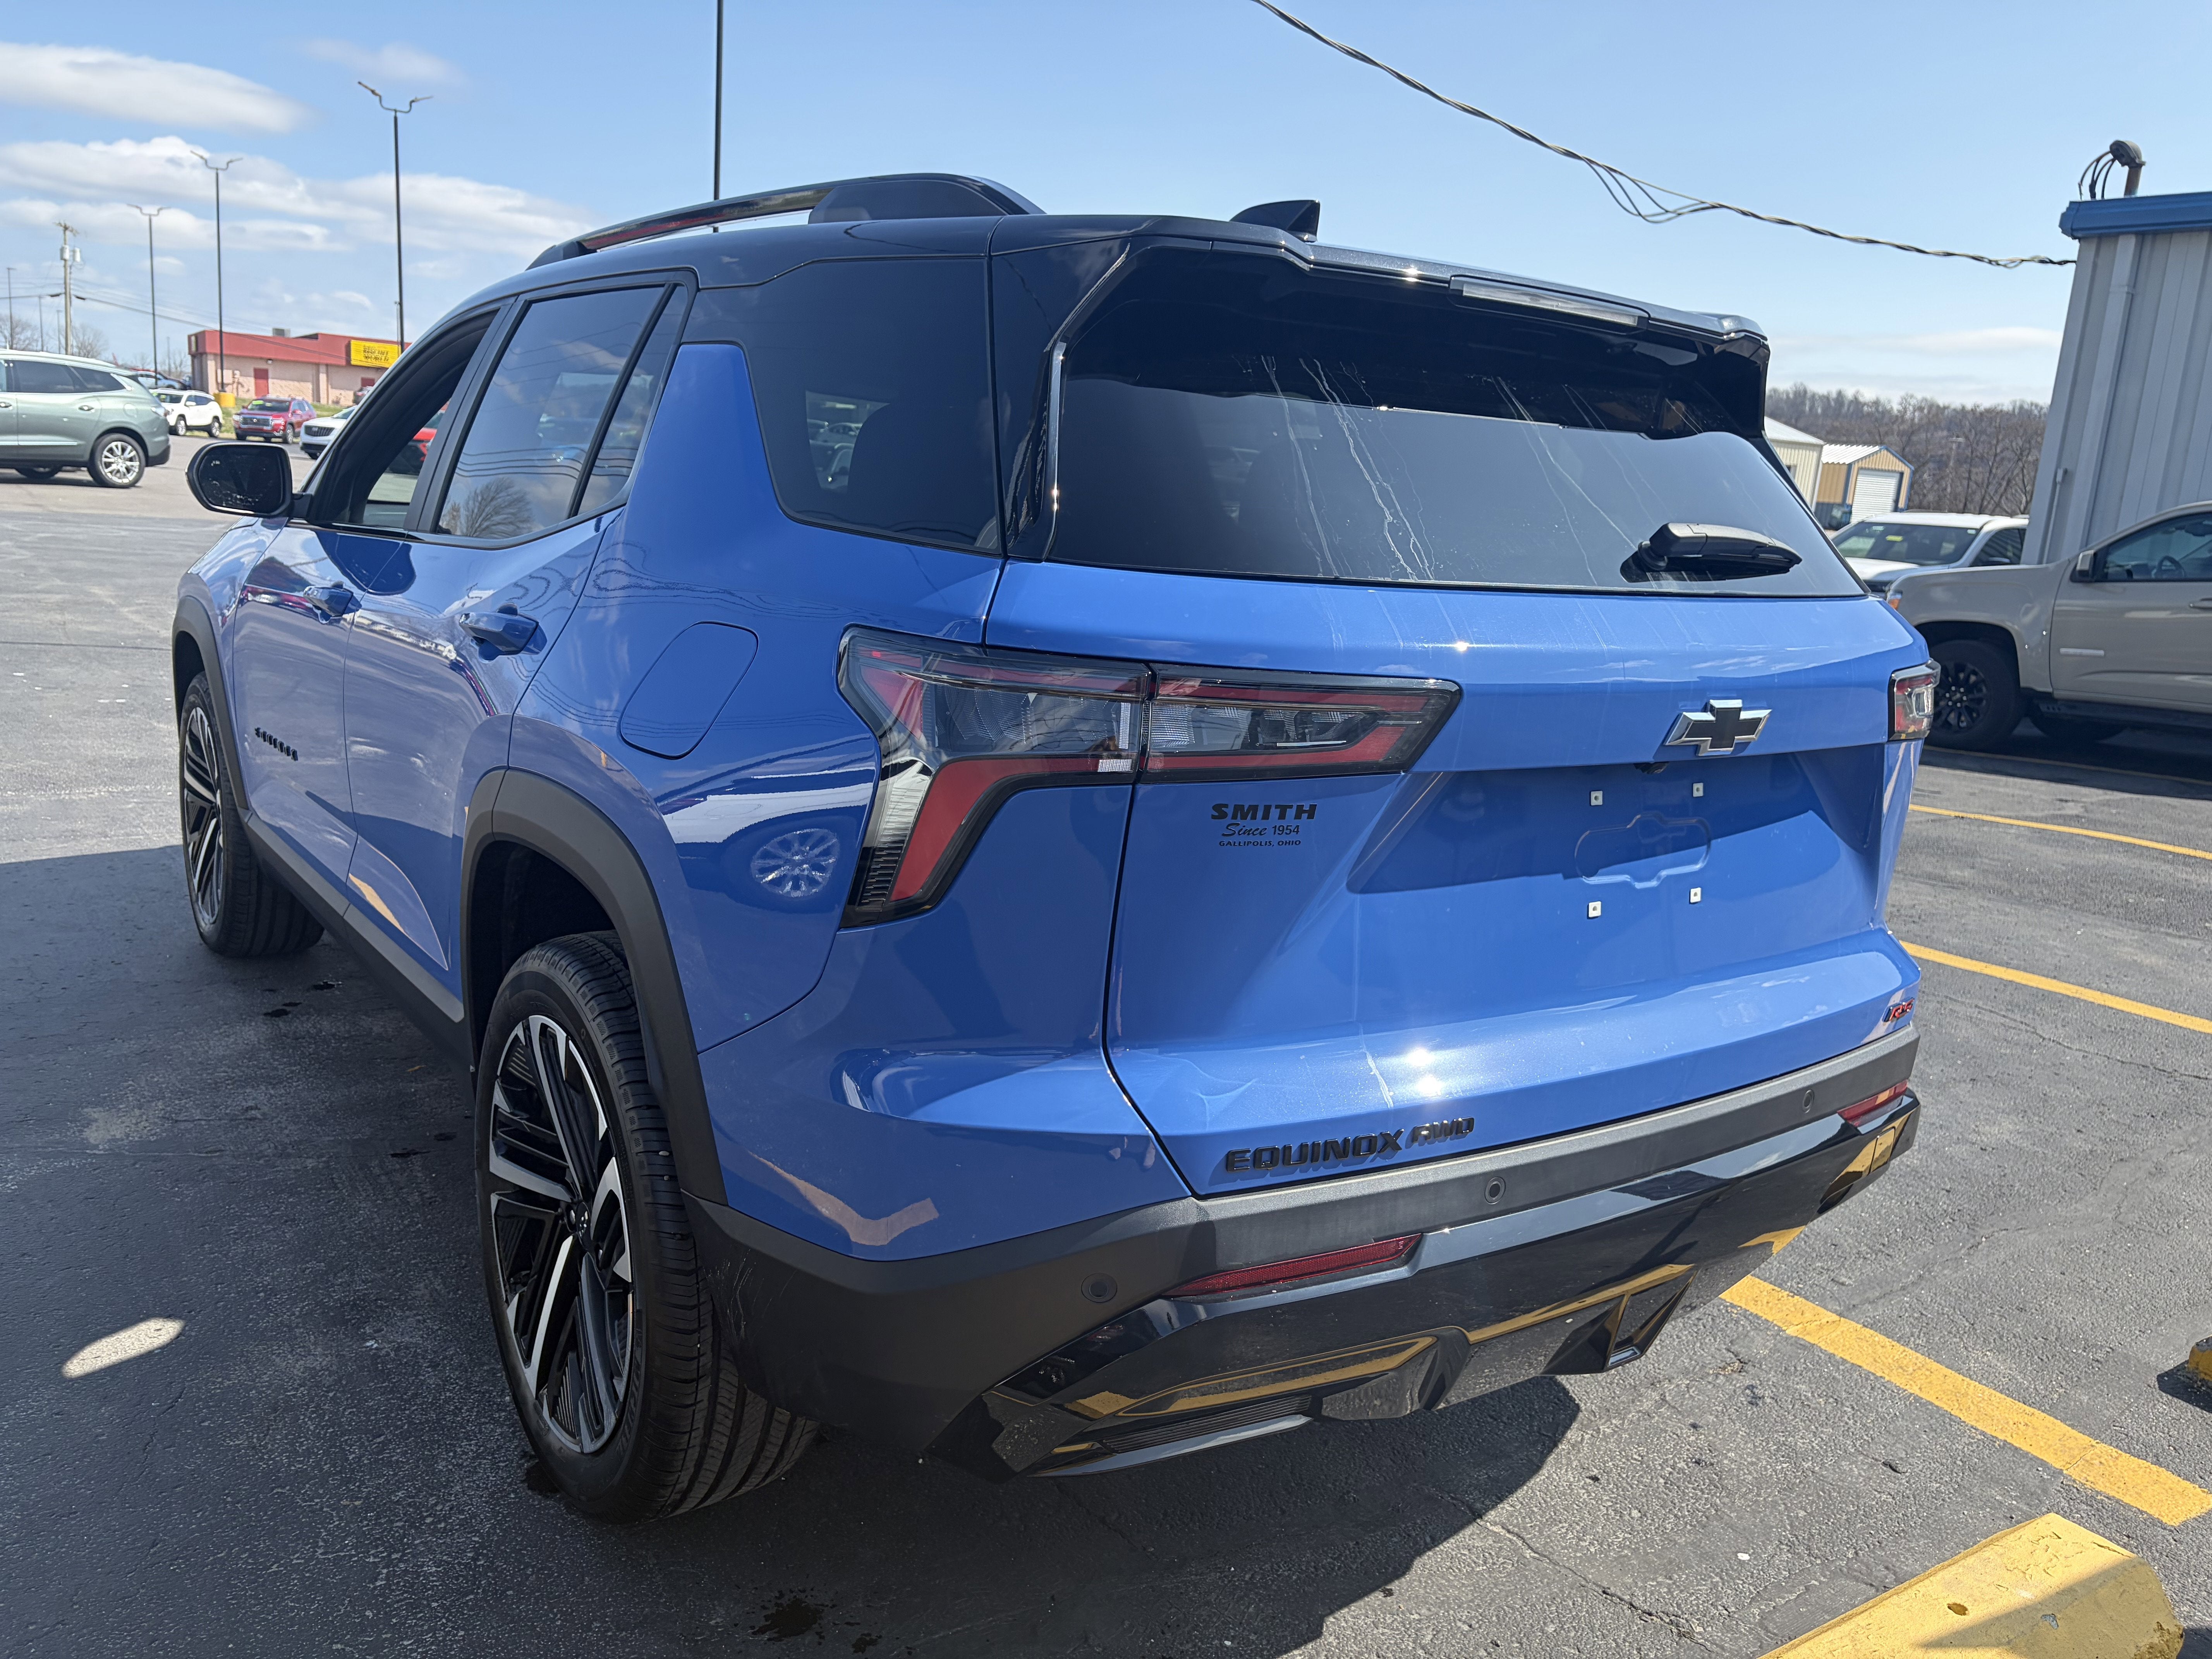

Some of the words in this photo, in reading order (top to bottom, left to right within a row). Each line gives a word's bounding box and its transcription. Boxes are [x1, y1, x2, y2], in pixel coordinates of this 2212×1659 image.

[1211, 804, 1317, 820] SMITH
[1222, 823, 1267, 836] Since
[1272, 825, 1300, 835] 1954
[1225, 1128, 1405, 1173] EQUINOX
[1411, 1117, 1475, 1144] AWD
